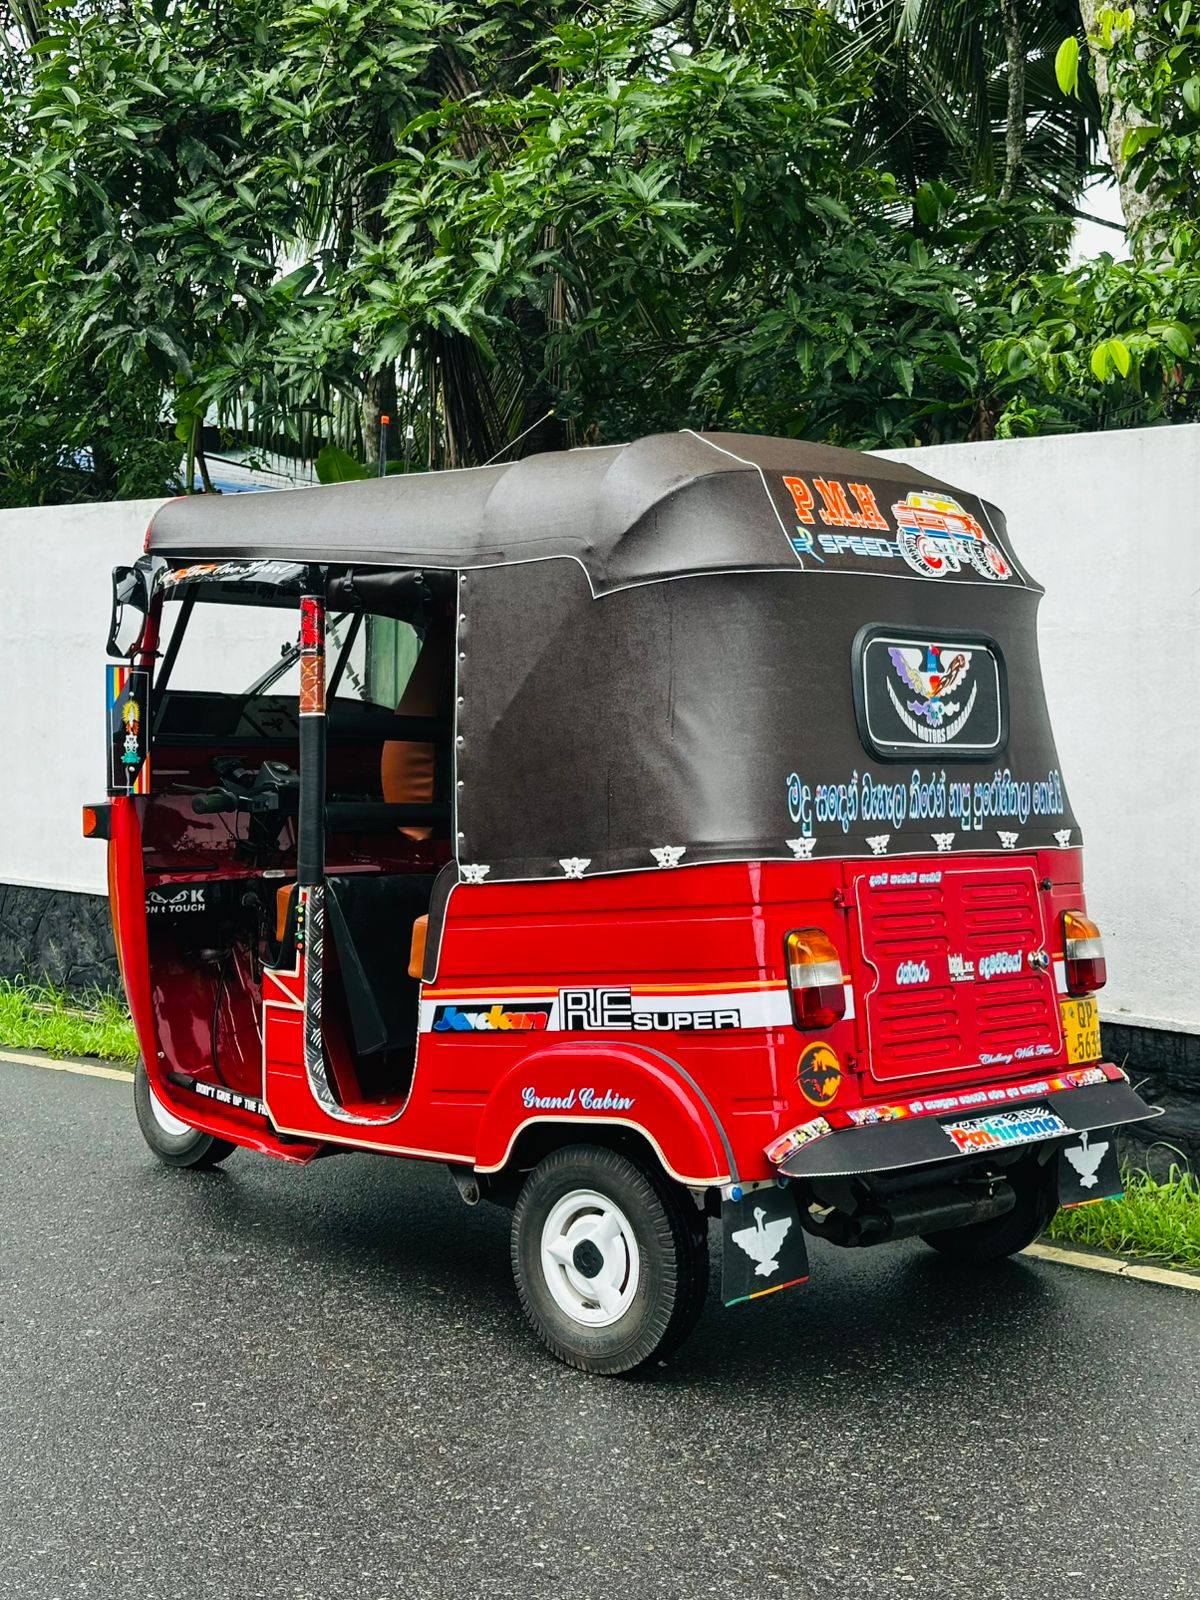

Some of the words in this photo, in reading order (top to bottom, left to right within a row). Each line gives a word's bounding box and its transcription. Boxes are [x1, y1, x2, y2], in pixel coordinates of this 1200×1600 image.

[817, 534, 893, 557] SPEED
[918, 724, 946, 743] MOTORS
[169, 904, 205, 913] TOUCH
[558, 987, 631, 1031] RE
[634, 1010, 740, 1031] SUPER
[216, 1090, 231, 1104] GIVE
[232, 1095, 242, 1107] UP
[244, 1099, 256, 1112] THE
[521, 1086, 577, 1109] Grand
[579, 1087, 636, 1111] Cabin
[950, 1114, 1060, 1149] Pathirana
